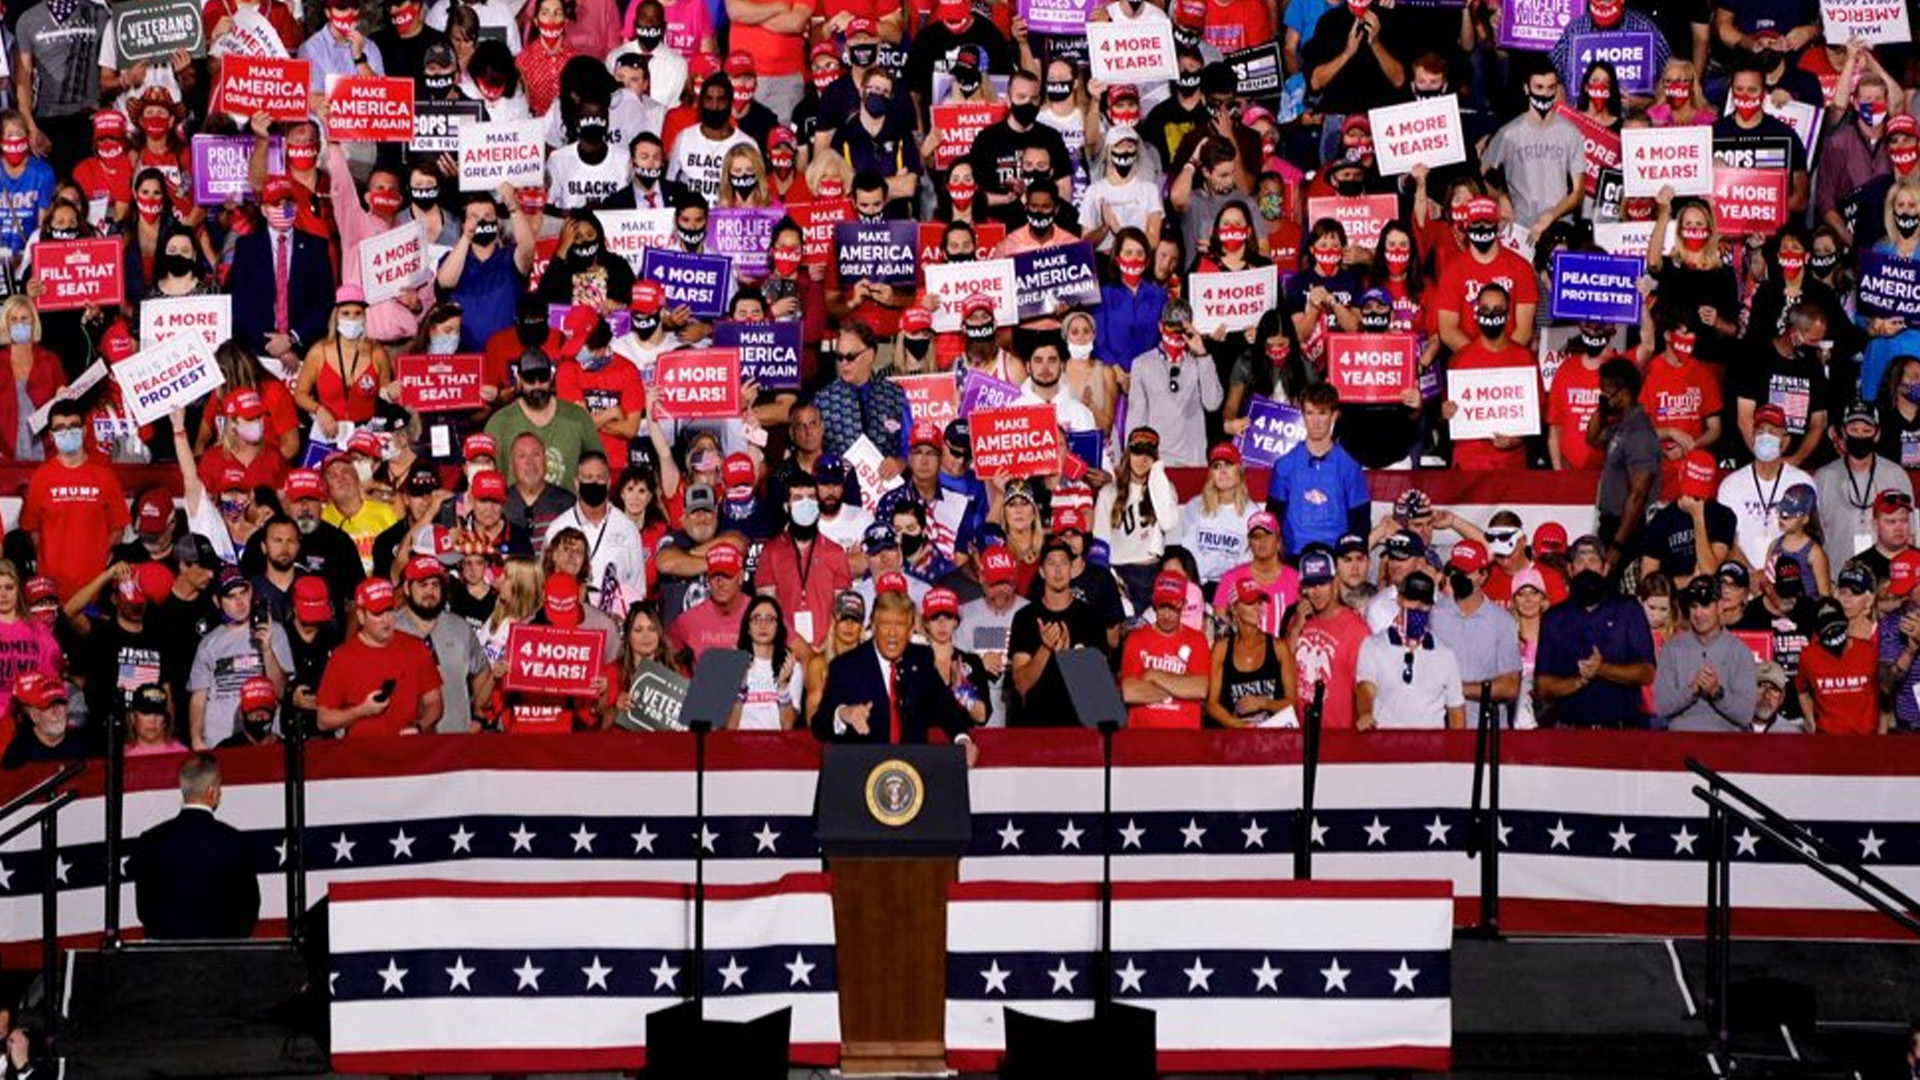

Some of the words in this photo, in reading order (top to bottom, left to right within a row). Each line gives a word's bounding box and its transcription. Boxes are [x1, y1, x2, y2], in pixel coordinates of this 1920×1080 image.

[127, 14, 194, 37] VETERANS
[1513, 13, 1554, 26] VOICES
[1100, 43, 1110, 52] 4
[1115, 37, 1161, 50] MORE
[1581, 50, 1592, 62] 4
[1596, 47, 1644, 61] MORE
[1104, 55, 1163, 71] YEARS!
[249, 66, 284, 79] MAKE
[226, 78, 306, 97] AMERICA
[1239, 77, 1277, 90] TRUMP
[351, 87, 387, 98] MAKE
[225, 94, 264, 109] GREAT
[267, 98, 305, 110] AGAIN
[330, 101, 410, 116] AMERICA
[329, 118, 368, 130] GREAT
[370, 117, 411, 129] AGAIN
[959, 114, 992, 124] MAKE
[1386, 125, 1395, 137] 4
[1399, 114, 1447, 134] MORE
[486, 132, 519, 143] MAKE
[412, 141, 435, 150] FOR
[1389, 135, 1450, 156] YEARS!
[1635, 148, 1645, 159] 4
[1650, 146, 1698, 159] MORE
[464, 145, 540, 163] AMERICA
[464, 166, 503, 178] GREAT
[507, 163, 540, 176] AGAIN
[1637, 165, 1698, 180] YEARS!
[568, 181, 618, 196] BLACKS
[1717, 186, 1728, 198] 4
[1732, 186, 1777, 200] MORE
[811, 211, 844, 222] MAKE
[1335, 206, 1370, 217] MAKE
[1720, 206, 1776, 220] YEARS!
[621, 221, 655, 232] MAKE
[716, 218, 771, 236] PRO-LIFE
[716, 237, 758, 252] VOICES
[858, 231, 891, 243] MAKE
[372, 255, 381, 266] 4
[385, 238, 420, 263] MORE
[839, 245, 914, 261] AMERICA
[840, 263, 873, 276] GREAT
[875, 261, 914, 274] AGAIN
[1033, 254, 1068, 270] MAKE
[40, 268, 72, 281] FILL
[75, 263, 115, 278] THAT
[376, 257, 421, 285] YEARS!
[653, 266, 664, 279] 4
[668, 268, 718, 285] MORE
[1016, 263, 1093, 290] AMERICA
[1881, 264, 1916, 281] MAKE
[942, 284, 950, 295] 4
[955, 278, 1002, 294] MORE
[1057, 280, 1095, 296] AGAIN
[1561, 271, 1634, 290] PEACEFUL
[56, 283, 100, 297] SEAT!
[1202, 289, 1212, 300] 4
[1217, 283, 1265, 300] MORE
[1561, 289, 1633, 305] PROTESTER
[1860, 291, 1894, 309] GREAT
[1205, 300, 1264, 317] YEARS!
[154, 315, 164, 327] 4
[169, 312, 218, 327] MORE
[740, 331, 775, 344] MAKE
[1339, 353, 1350, 366] 4
[1354, 351, 1404, 367] MORE
[133, 354, 203, 395] PEACEFUL
[664, 371, 675, 382] 4
[679, 366, 728, 382] MORE
[758, 365, 797, 377] AGAIN
[1341, 371, 1402, 386] YEARS!
[139, 364, 209, 409] PROTEST
[402, 375, 433, 388] FILL
[439, 373, 479, 386] THAT
[419, 387, 462, 401] SEAT!
[664, 387, 726, 402] YEARS!
[1461, 388, 1472, 401] 4
[1477, 385, 1525, 401] MORE
[1464, 404, 1525, 421] YEARS!
[994, 417, 1030, 431] MAKE
[1254, 416, 1265, 429] 4
[975, 431, 1056, 452] AMERICA
[977, 452, 1016, 466] GREAT
[1017, 449, 1057, 464] AGAIN
[50, 486, 99, 498] TRUMP
[1198, 531, 1240, 549] TRUMP
[520, 642, 531, 657] 4
[537, 644, 591, 661] MORE
[520, 661, 587, 680] YEARS!
[1816, 676, 1868, 688] TRUMP
[513, 706, 562, 717] TRUMP
